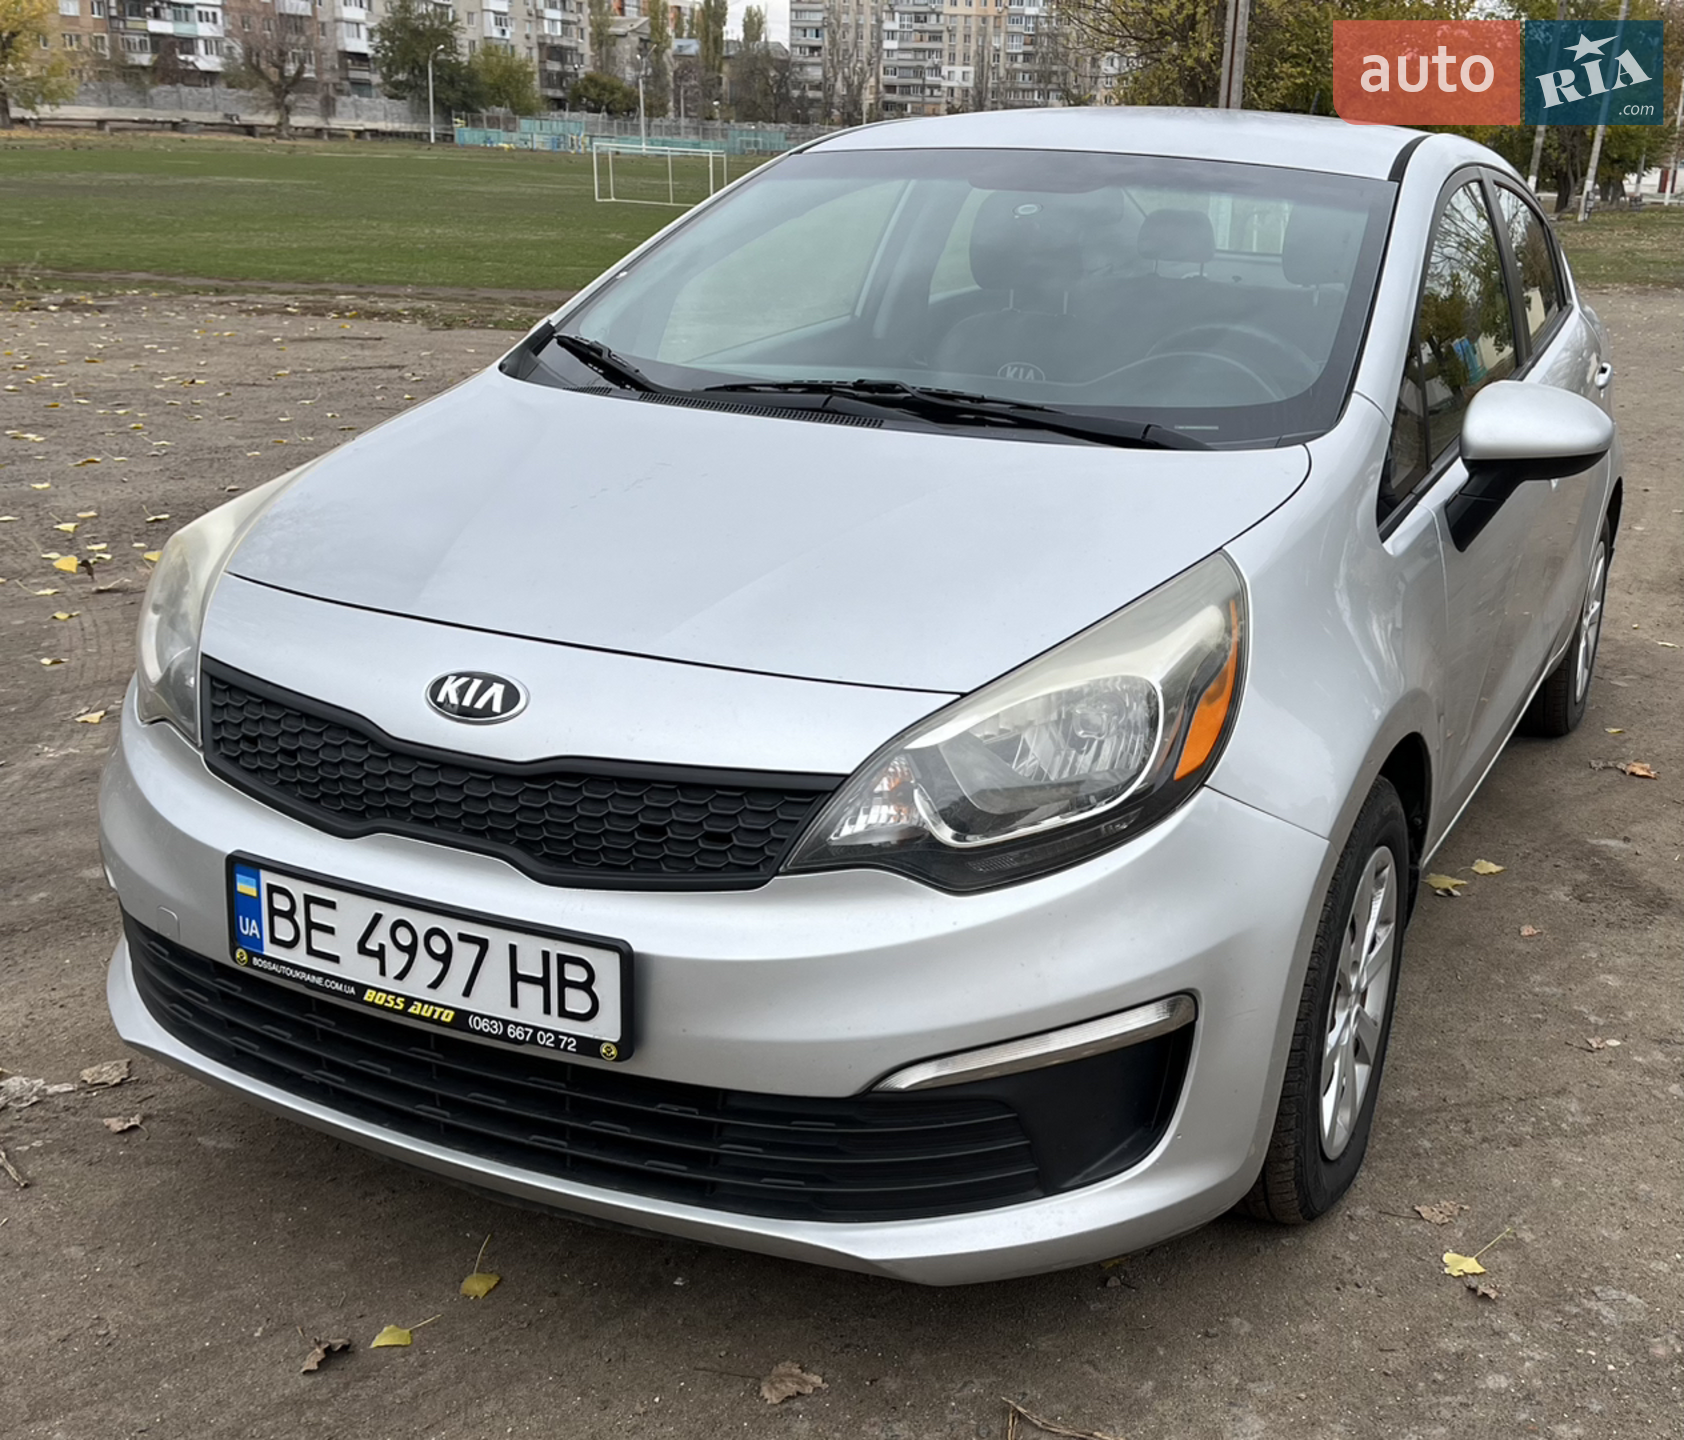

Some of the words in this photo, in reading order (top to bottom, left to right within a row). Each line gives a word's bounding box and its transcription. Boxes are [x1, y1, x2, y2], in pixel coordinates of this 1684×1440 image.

[1006, 365, 1035, 380] KIA
[436, 675, 505, 713] KIA
[239, 915, 261, 939] UA
[266, 882, 340, 964] BE
[357, 912, 489, 998] 4997
[509, 943, 600, 1022] HB
[252, 956, 356, 995] BOSSAUTOUKRAINE.COM.UA
[363, 988, 405, 1010] BOSS
[407, 1001, 455, 1023] AUTO
[468, 1014, 503, 1035] (063)
[507, 1023, 533, 1041] 667
[536, 1031, 555, 1047] 02
[558, 1035, 577, 1052] 72
